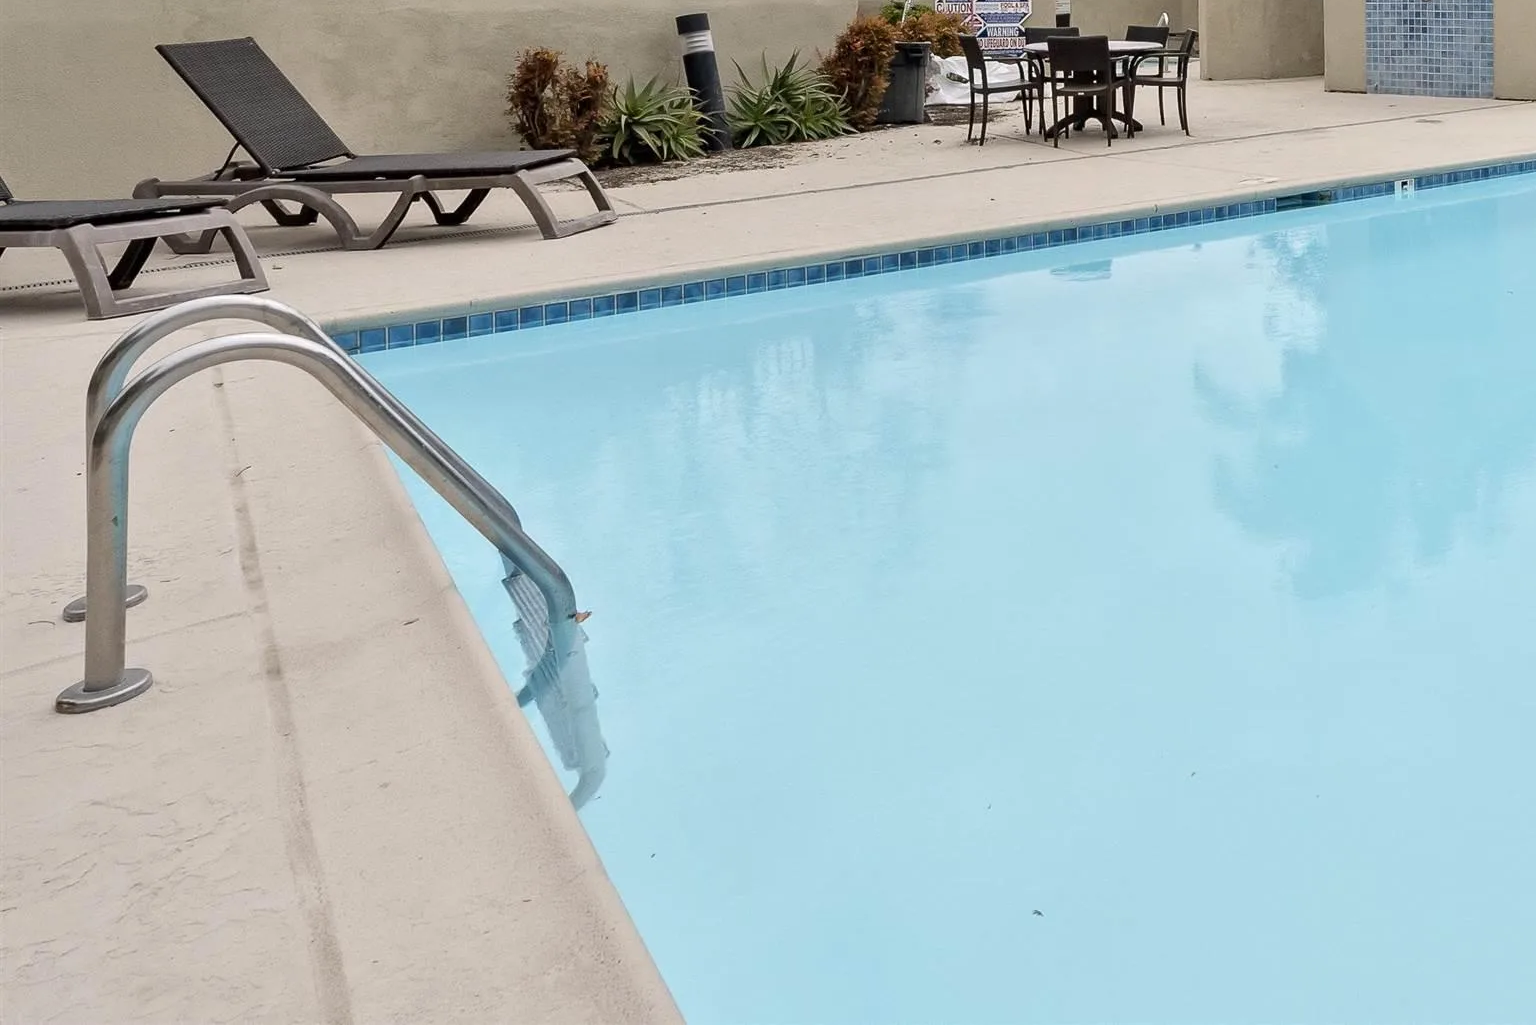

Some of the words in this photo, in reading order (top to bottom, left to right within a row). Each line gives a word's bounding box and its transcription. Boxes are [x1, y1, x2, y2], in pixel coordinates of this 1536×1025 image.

[986, 27, 1019, 37] WARNING
[984, 38, 1009, 48] LIFEGUARD
[1010, 38, 1018, 48] ON
